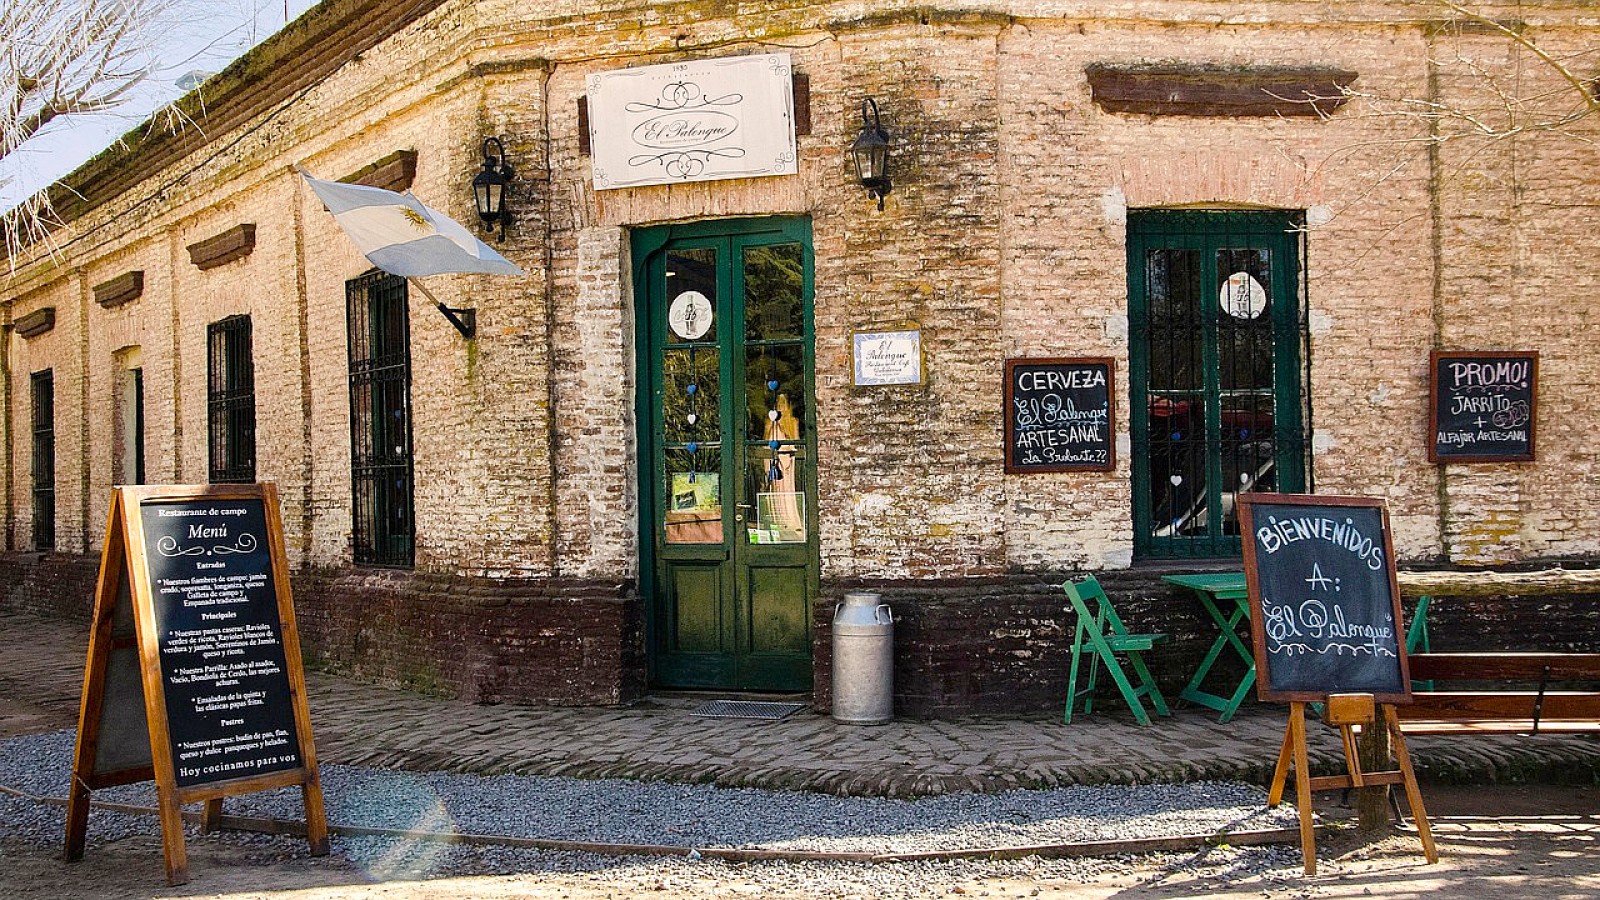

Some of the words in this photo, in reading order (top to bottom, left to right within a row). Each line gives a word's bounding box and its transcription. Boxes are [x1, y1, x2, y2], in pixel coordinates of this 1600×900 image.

[644, 121, 669, 140] El
[666, 120, 727, 140] Palenque
[1019, 370, 1106, 391] CERVEZA
[1448, 361, 1528, 388] PROMO!
[1016, 426, 1103, 448] ARTESANAL
[158, 509, 207, 517] Restaurante
[188, 523, 228, 539] Menú
[1305, 562, 1340, 592] A:
[218, 589, 239, 597] campo
[184, 598, 216, 608] Empanada
[201, 611, 237, 620] Principales
[191, 673, 218, 681] Bondiola
[258, 667, 280, 675] mejores
[196, 695, 226, 704] Ensaladas
[243, 690, 261, 700] quinta
[230, 701, 246, 710] papas
[183, 741, 210, 749] Nuestros
[180, 752, 199, 760] queso
[205, 747, 222, 755] dulce
[180, 767, 201, 776] Hoy
[203, 760, 254, 773] cocinamos
[256, 757, 277, 768] para
